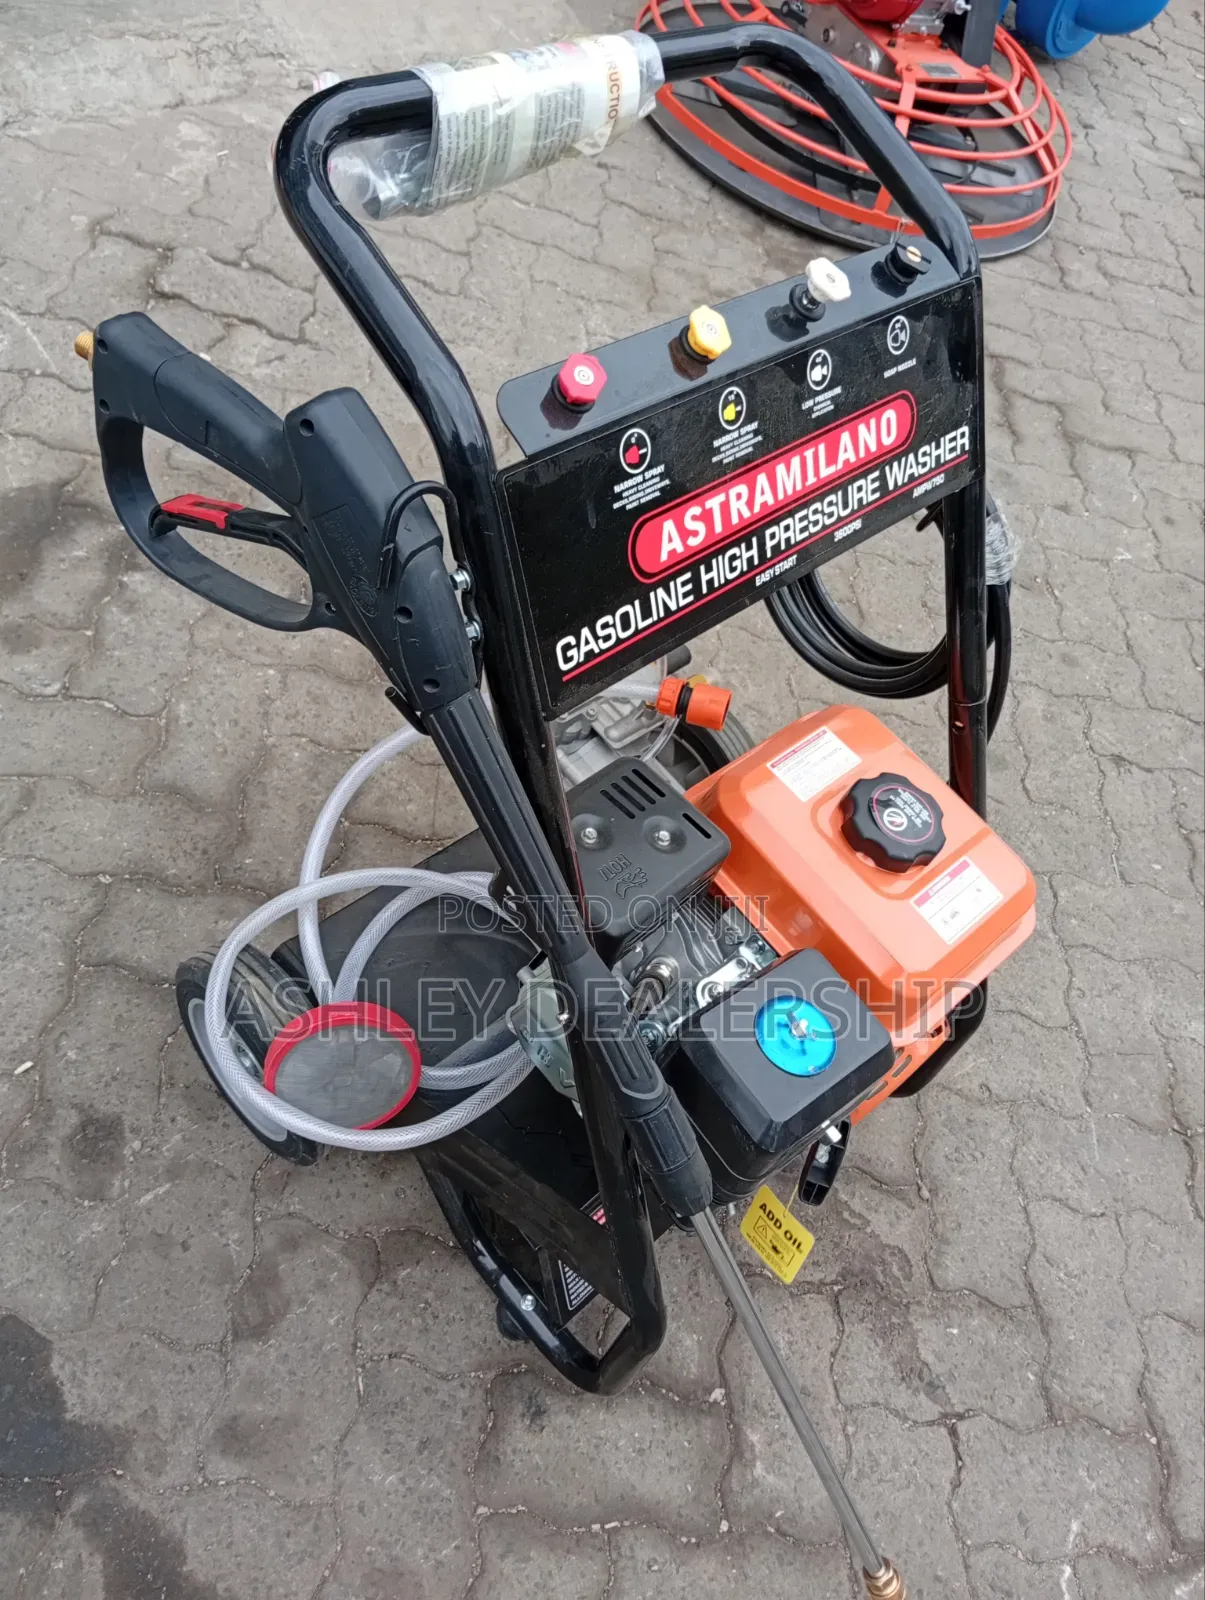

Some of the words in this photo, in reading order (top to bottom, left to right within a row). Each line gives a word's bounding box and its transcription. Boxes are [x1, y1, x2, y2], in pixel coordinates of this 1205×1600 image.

[897, 357, 917, 372] NOZZLE
[801, 398, 814, 410] LOW
[814, 385, 842, 404] PRESSURE
[713, 430, 740, 448] NARROW
[740, 420, 759, 436] SPRAY
[613, 475, 644, 494] NARROW
[644, 464, 666, 480] SPRAY
[637, 476, 661, 491] CLEANING
[659, 407, 898, 563] ASTRAMILANO
[555, 571, 695, 672] GASOLINE
[700, 540, 760, 595] HIGH
[765, 469, 881, 564] PRESSURE
[885, 425, 971, 491] WASHER
[755, 569, 775, 587] EASY
[774, 554, 798, 576] START
[759, 1202, 783, 1230] ADD
[783, 1229, 804, 1254] OIL
